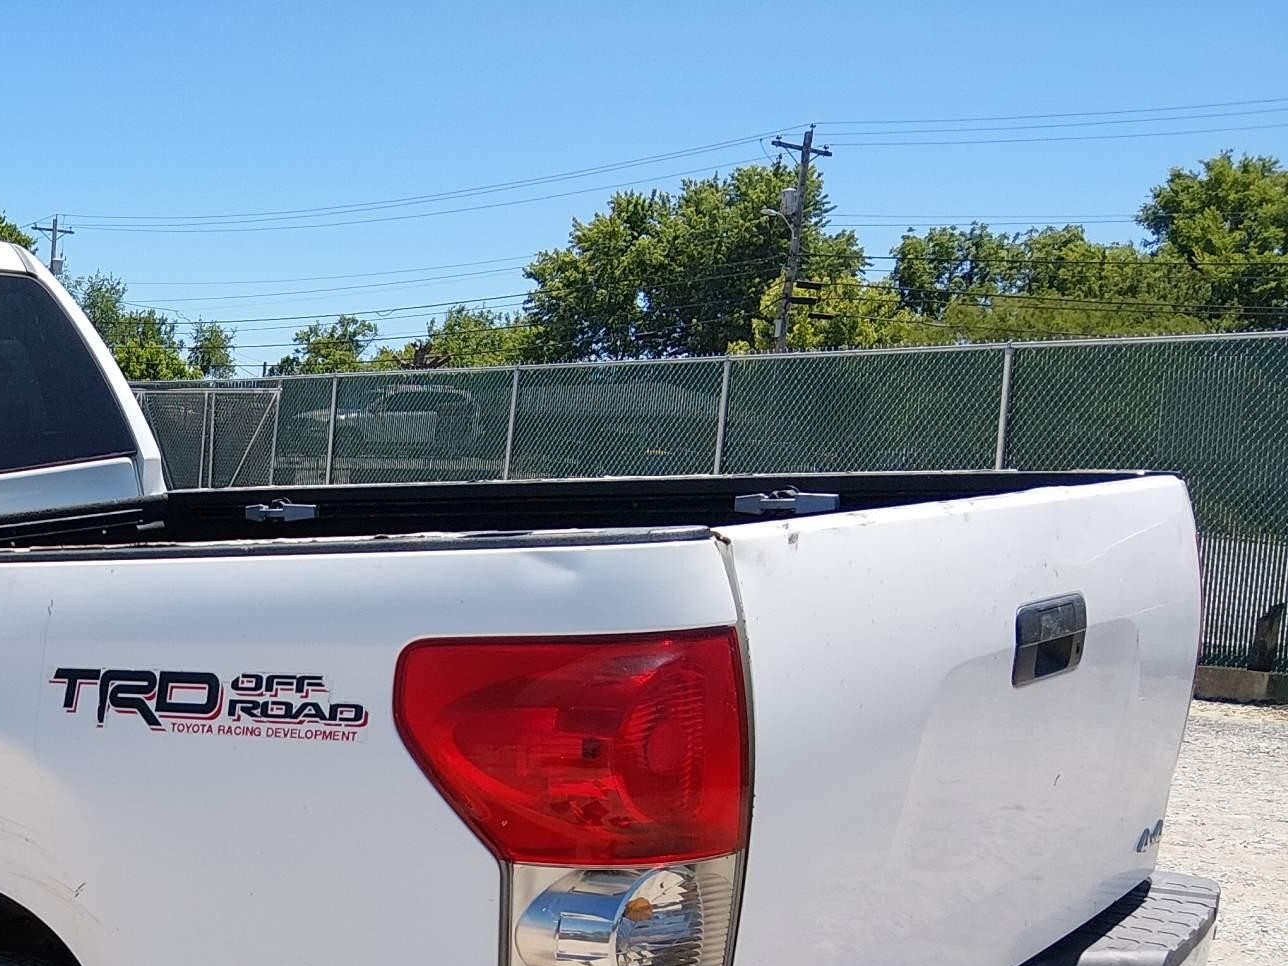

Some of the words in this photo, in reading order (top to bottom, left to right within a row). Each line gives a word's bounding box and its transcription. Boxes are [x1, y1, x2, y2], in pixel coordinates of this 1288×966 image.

[230, 673, 329, 698] OFF
[49, 667, 225, 731] TRD
[227, 699, 369, 727] ROAD
[170, 721, 213, 736] TOYOTA
[217, 724, 262, 738] RACING
[265, 727, 358, 742] DEVELOPMENT
